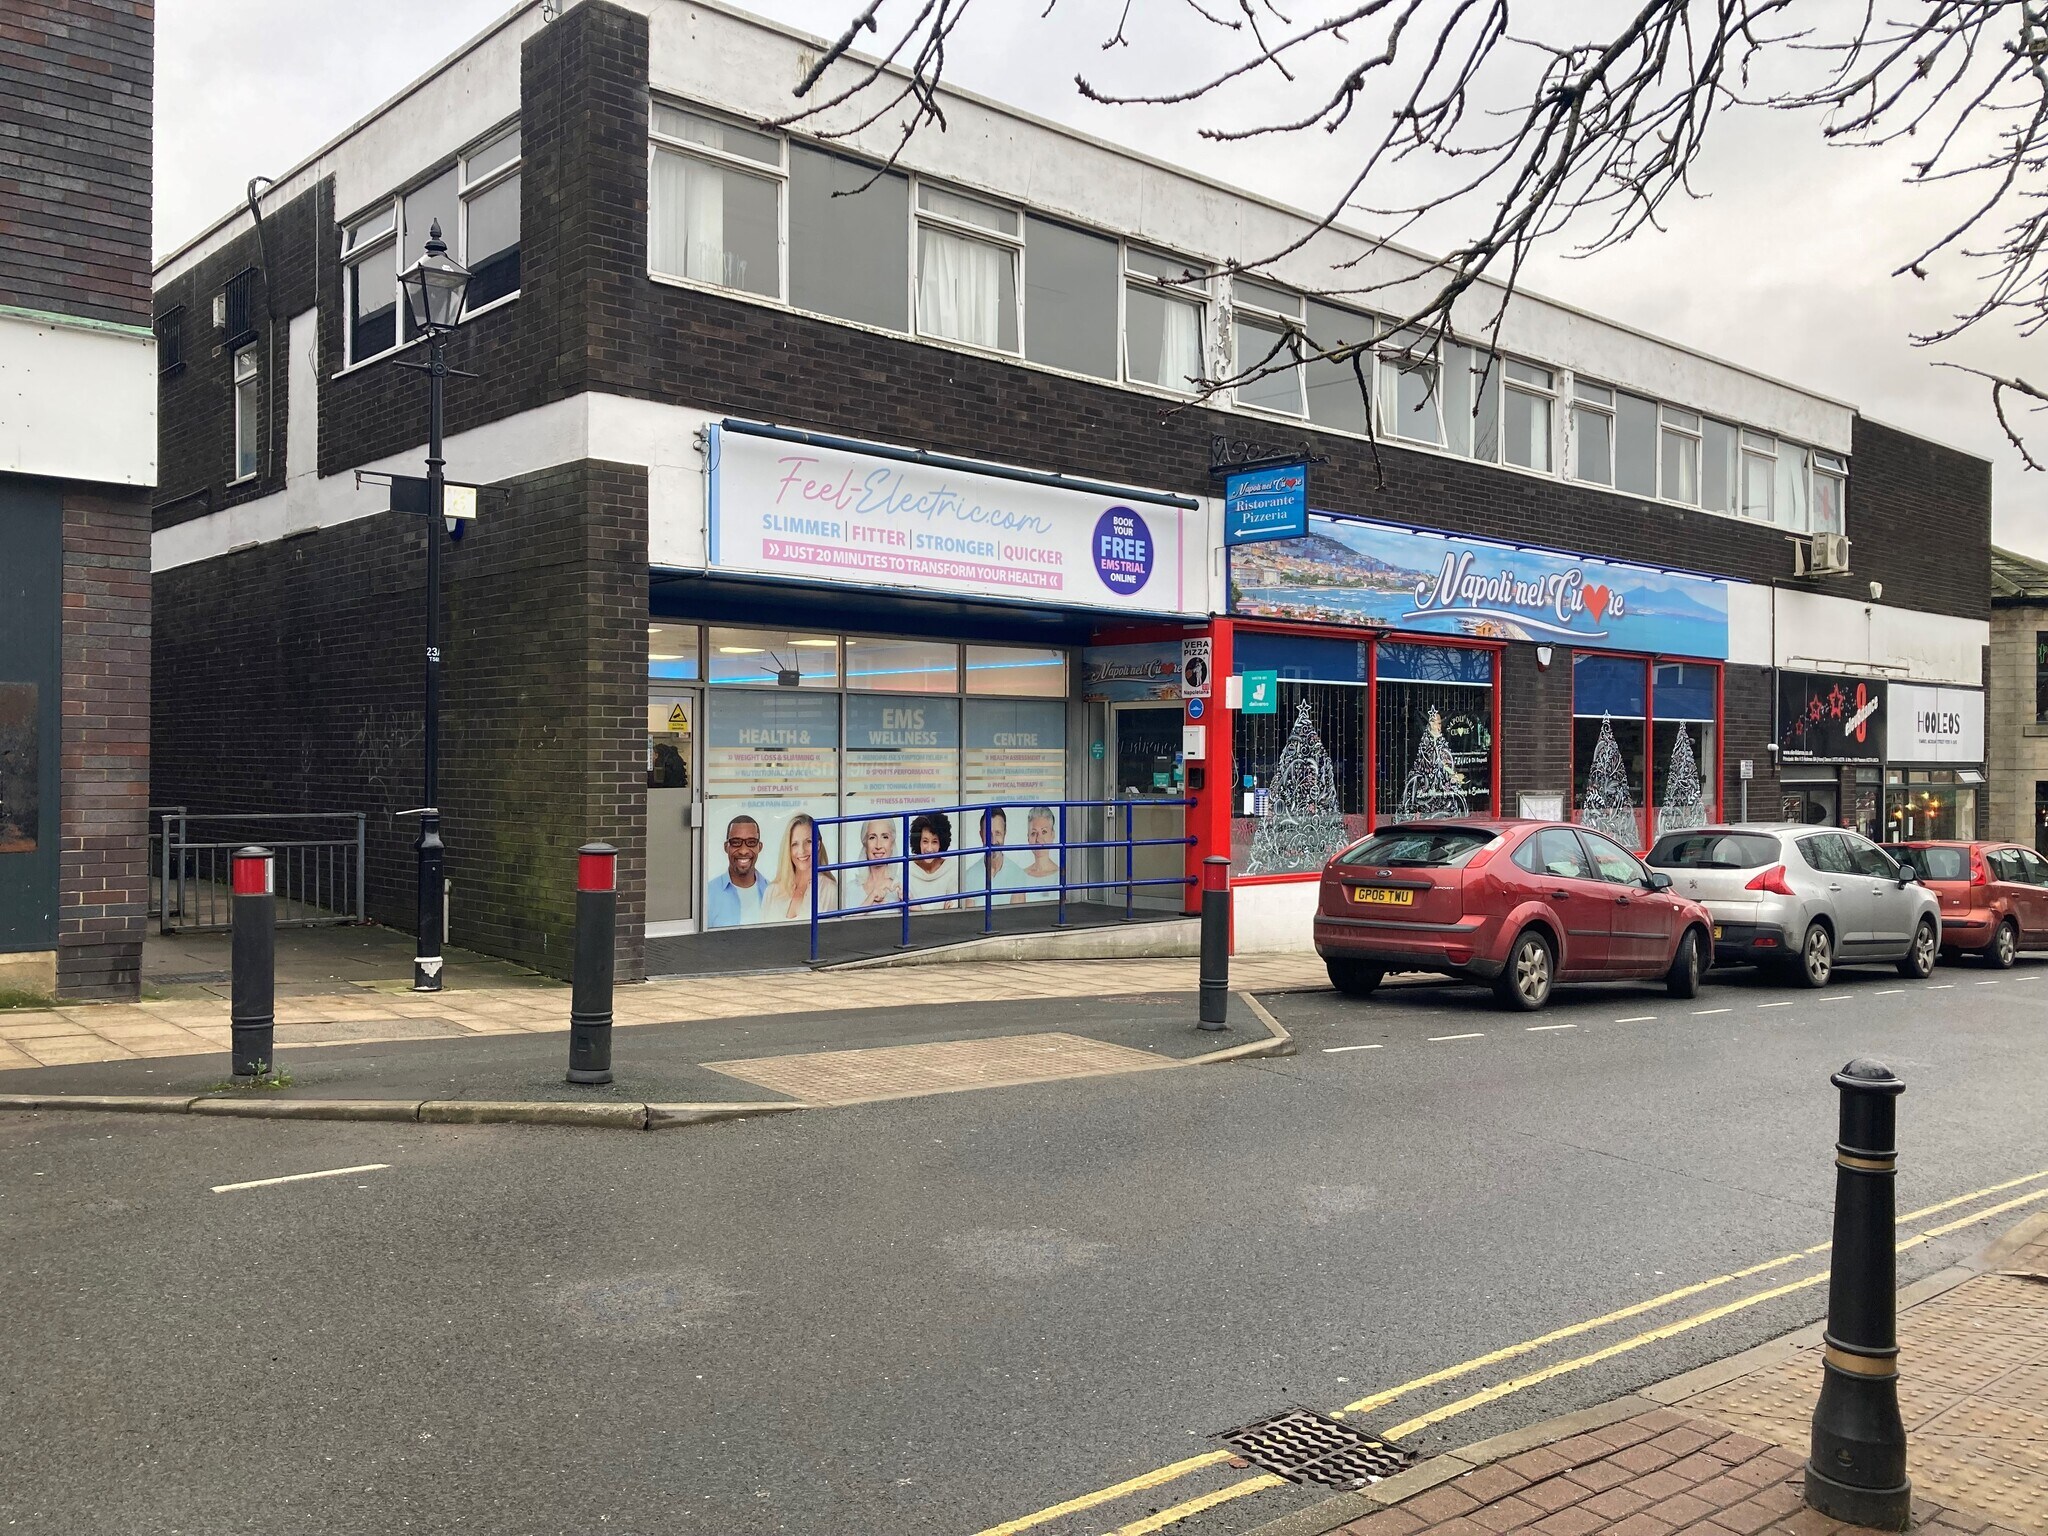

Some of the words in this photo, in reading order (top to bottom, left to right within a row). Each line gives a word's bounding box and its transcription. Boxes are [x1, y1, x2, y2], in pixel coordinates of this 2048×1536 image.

[775, 456, 1052, 534] Feel-Electric.com
[1235, 496, 1295, 512] Ristorante
[1113, 516, 1134, 527] BOOK
[1242, 508, 1288, 524] Pizzeria
[1113, 525, 1133, 536] YOUR
[762, 513, 841, 539] SLIMMER
[852, 525, 906, 547] FITTER
[916, 533, 994, 558] STRONGER
[1003, 545, 1063, 566] QUICKER
[1101, 535, 1146, 562] FREE
[782, 544, 815, 561] JUST
[816, 549, 832, 563] 20
[833, 550, 888, 569] MINUTES
[889, 557, 905, 570] TO
[906, 558, 976, 579] TRANSFORM
[977, 567, 1007, 582] YOUR
[1008, 569, 1047, 586] HEALTH
[1101, 558, 1120, 570] EMS
[1120, 561, 1145, 574] TRIAL
[1110, 572, 1137, 584] ONLINE
[1413, 550, 1514, 609] Napoli
[1514, 573, 1546, 607] nel
[1183, 648, 1209, 656] PIZZA
[1184, 640, 1210, 649] VERA
[1091, 660, 1129, 681] Napoli
[1130, 665, 1143, 675] nel
[882, 707, 925, 730] EMS
[1917, 711, 1961, 735] HOOLEOS
[739, 728, 797, 744] HEALTH
[800, 730, 811, 745] &
[868, 731, 938, 745] WELLNESS
[993, 732, 1038, 746] CENTRE
[869, 783, 886, 791] BODY
[1358, 888, 1385, 901] GP06
[1388, 890, 1409, 903] TWU
